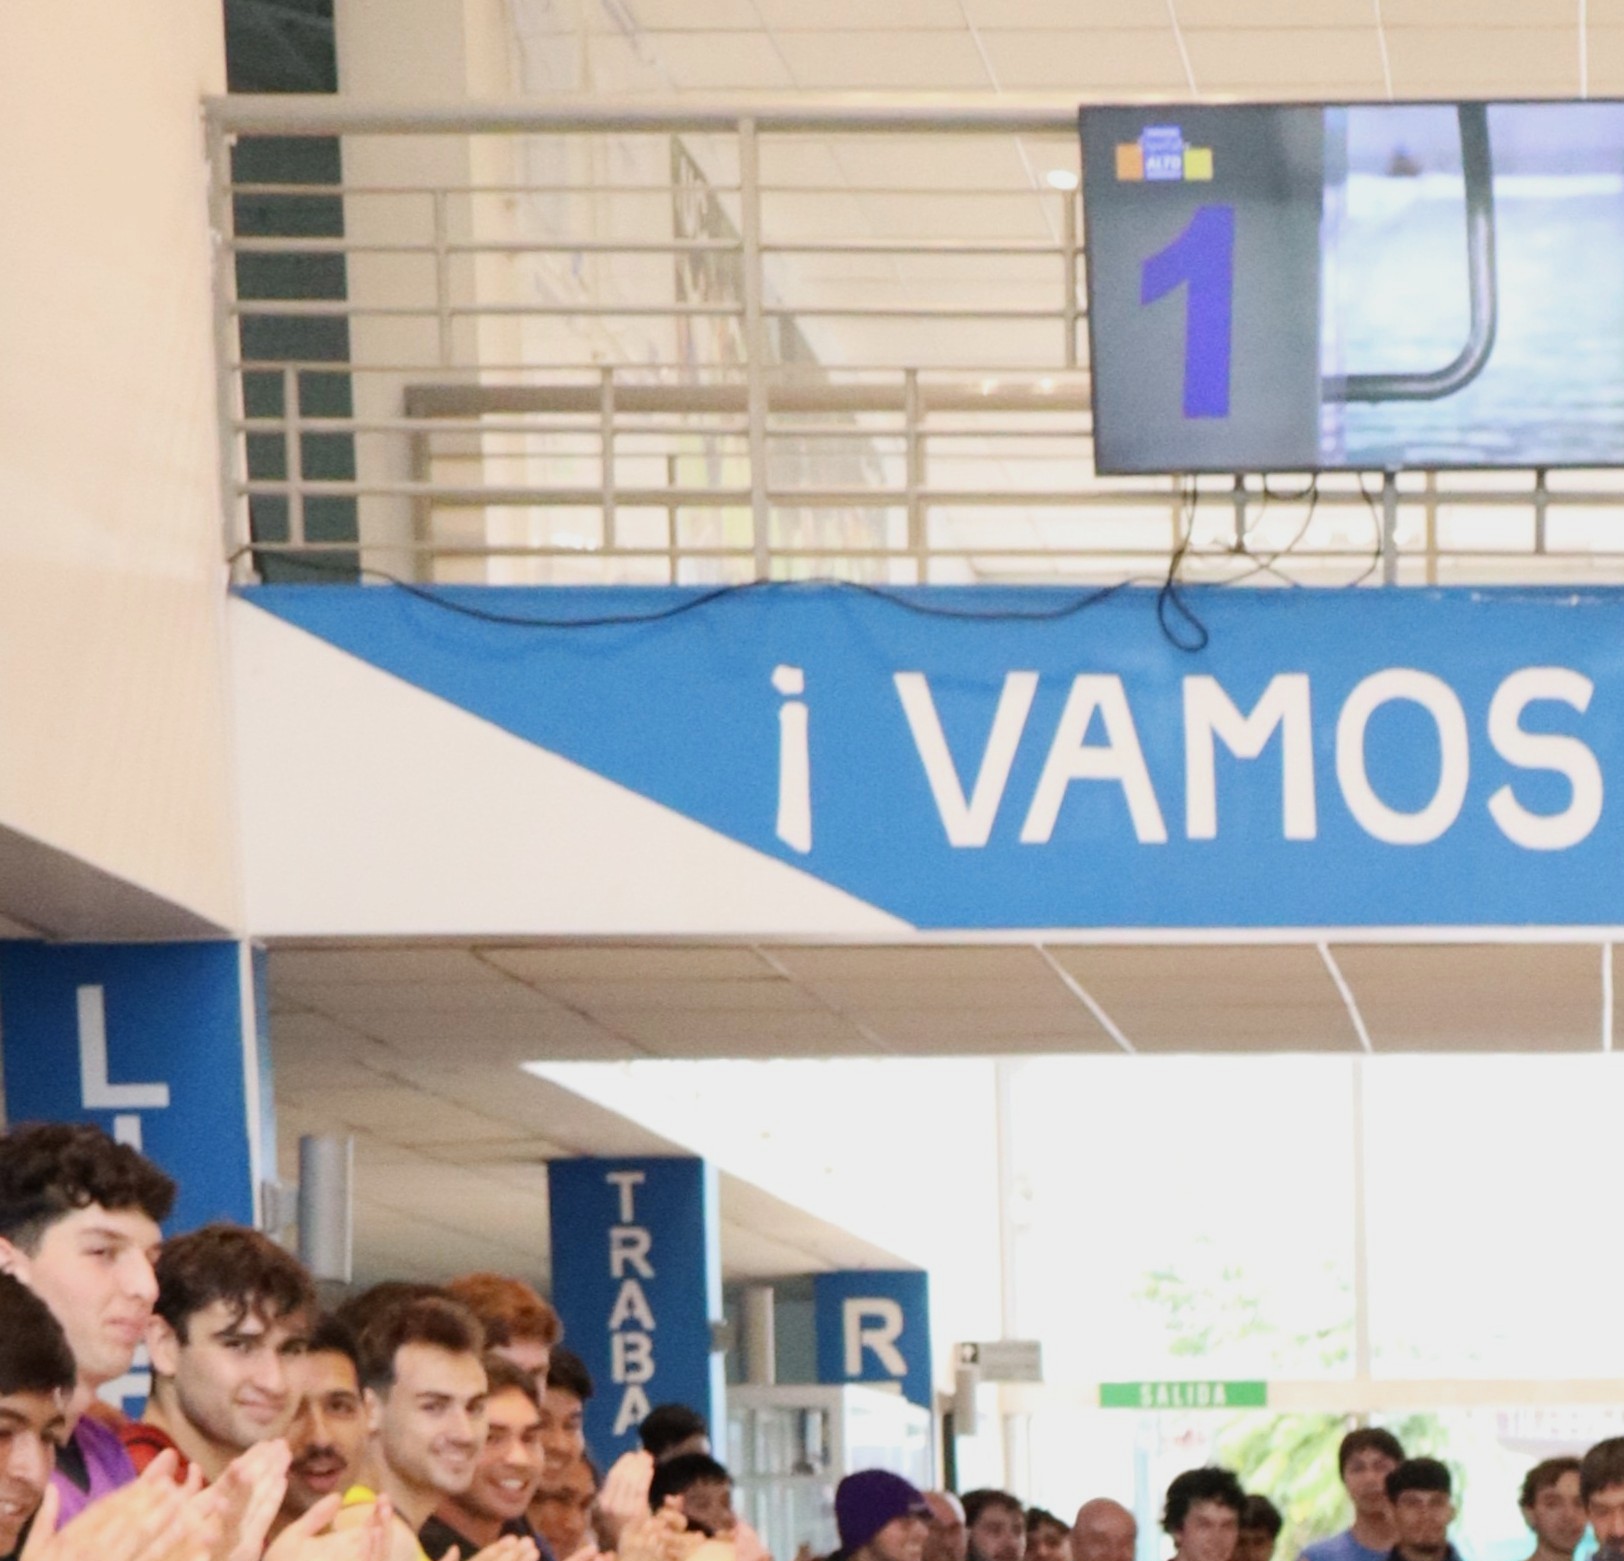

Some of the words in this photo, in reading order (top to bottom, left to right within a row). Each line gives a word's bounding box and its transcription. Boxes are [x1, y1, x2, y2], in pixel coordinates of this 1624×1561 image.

[1141, 205, 1235, 418] 1
[893, 667, 1603, 850] VAMOS
[842, 1298, 908, 1377] R
[1140, 1382, 1227, 1408] SALIDA
